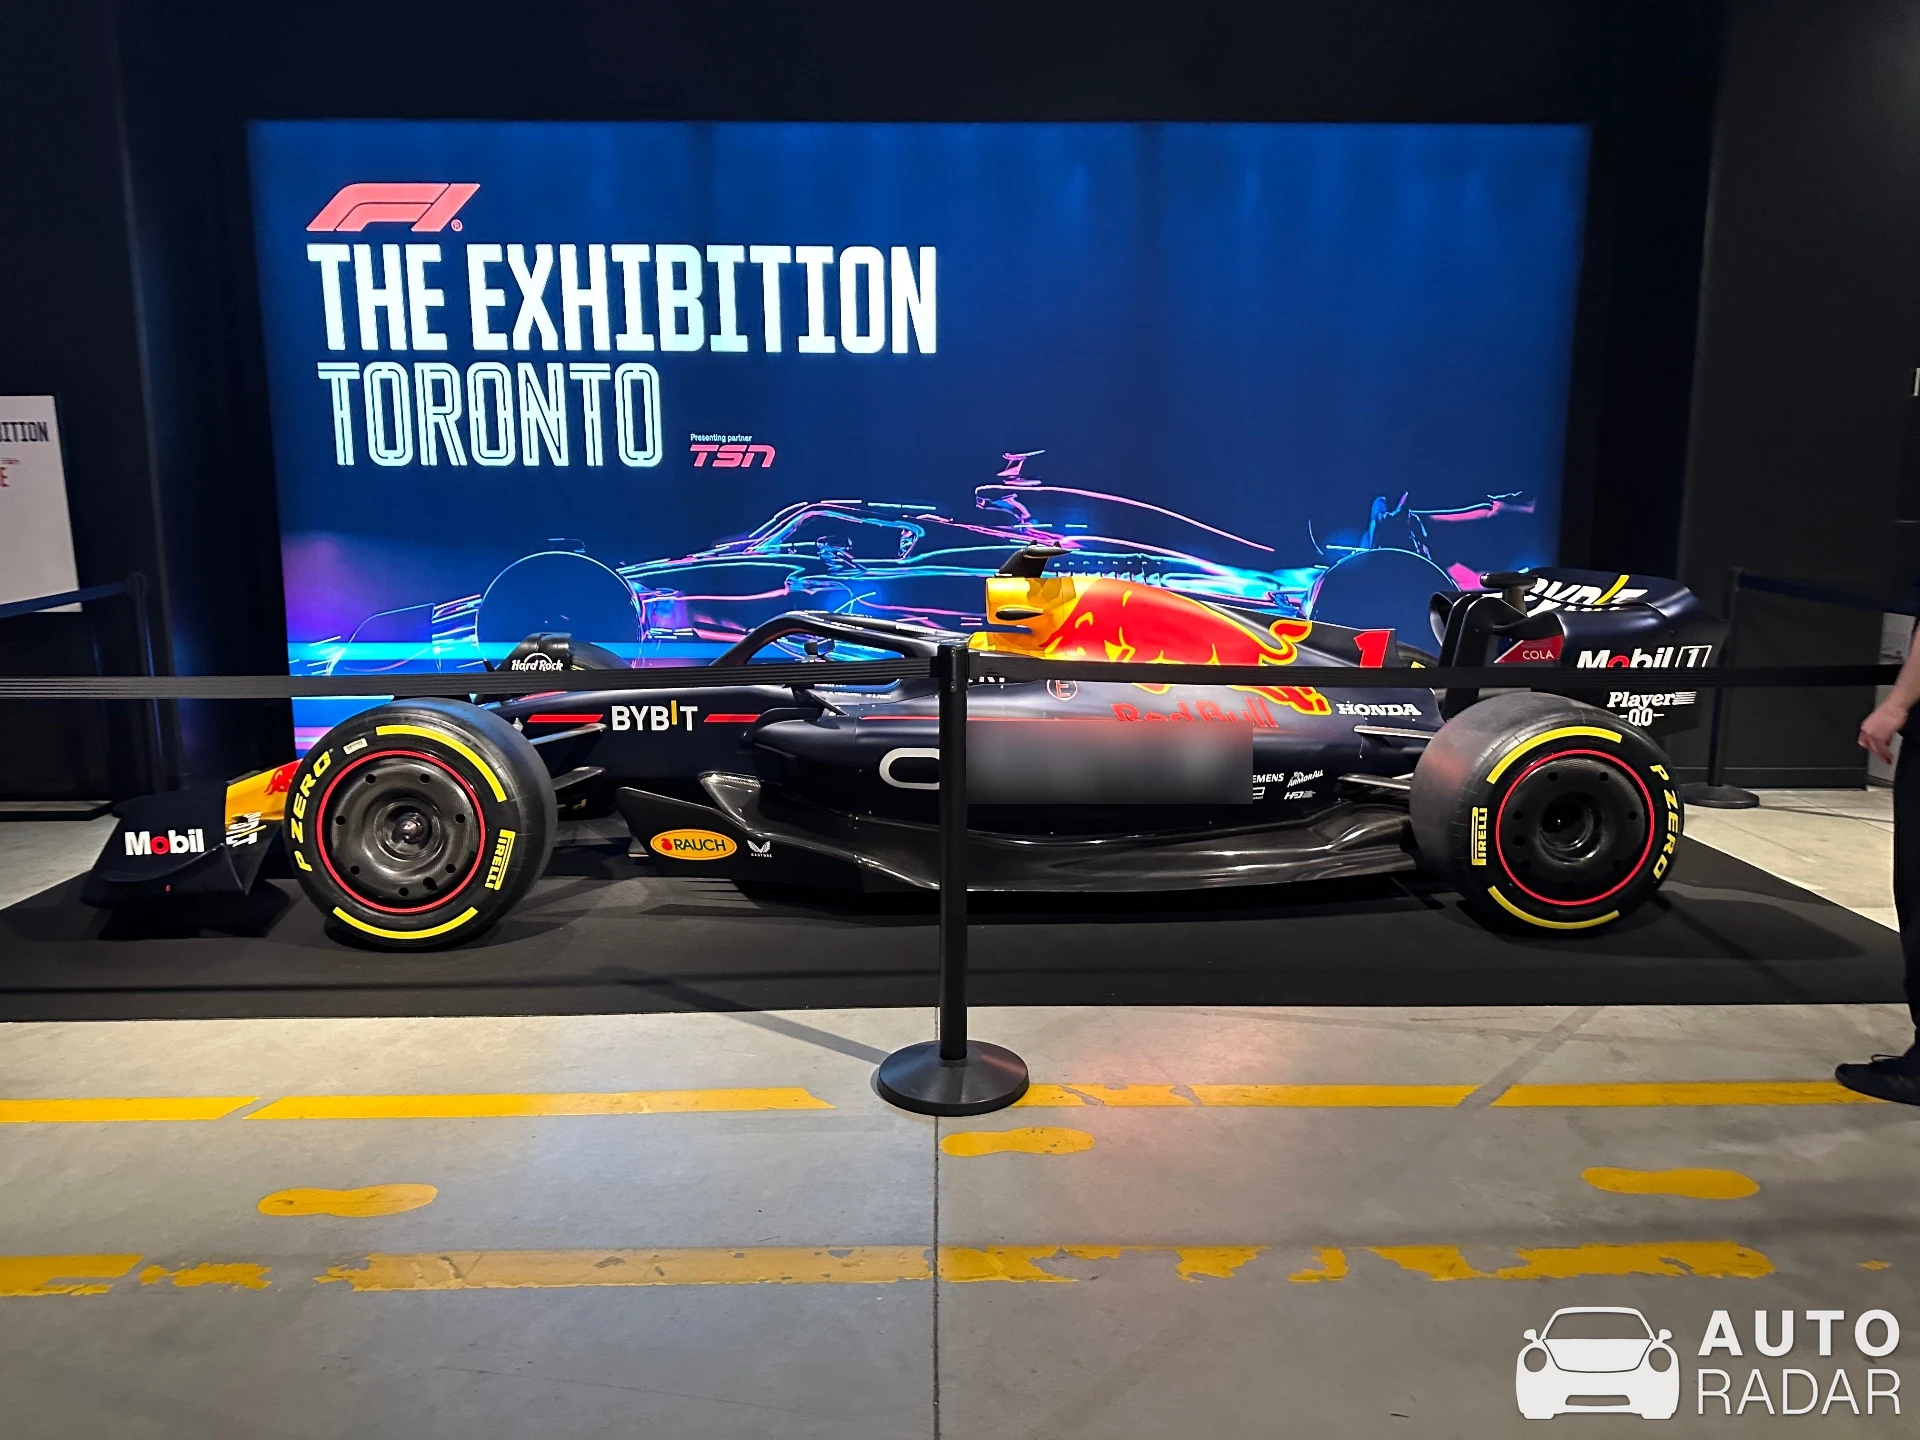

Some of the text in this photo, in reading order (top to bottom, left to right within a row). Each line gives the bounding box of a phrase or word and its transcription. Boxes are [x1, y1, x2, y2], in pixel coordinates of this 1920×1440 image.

[305, 182, 481, 233] F1
[306, 243, 937, 354] THE EXHIBITION
[317, 361, 664, 468] TORONTO
[0, 421, 50, 442] ITION
[690, 433, 752, 443] Presenting partner
[689, 444, 776, 468] TSN
[1354, 630, 1391, 668] 1
[1522, 650, 1555, 660] COLA
[1577, 648, 1674, 668] Mobil
[511, 659, 564, 672] Hard Rock
[1337, 702, 1422, 716] HONDA
[1607, 692, 1675, 711] Player
[611, 700, 698, 731] BYBIT
[1253, 772, 1285, 784] EMENS
[291, 750, 332, 872] P ZERO
[1649, 764, 1680, 879] P ZERO
[125, 828, 204, 855] Mobil
[674, 838, 727, 852] RAUCH
[1471, 806, 1488, 866] PIRELLI
[484, 829, 516, 890] PIRELLI
